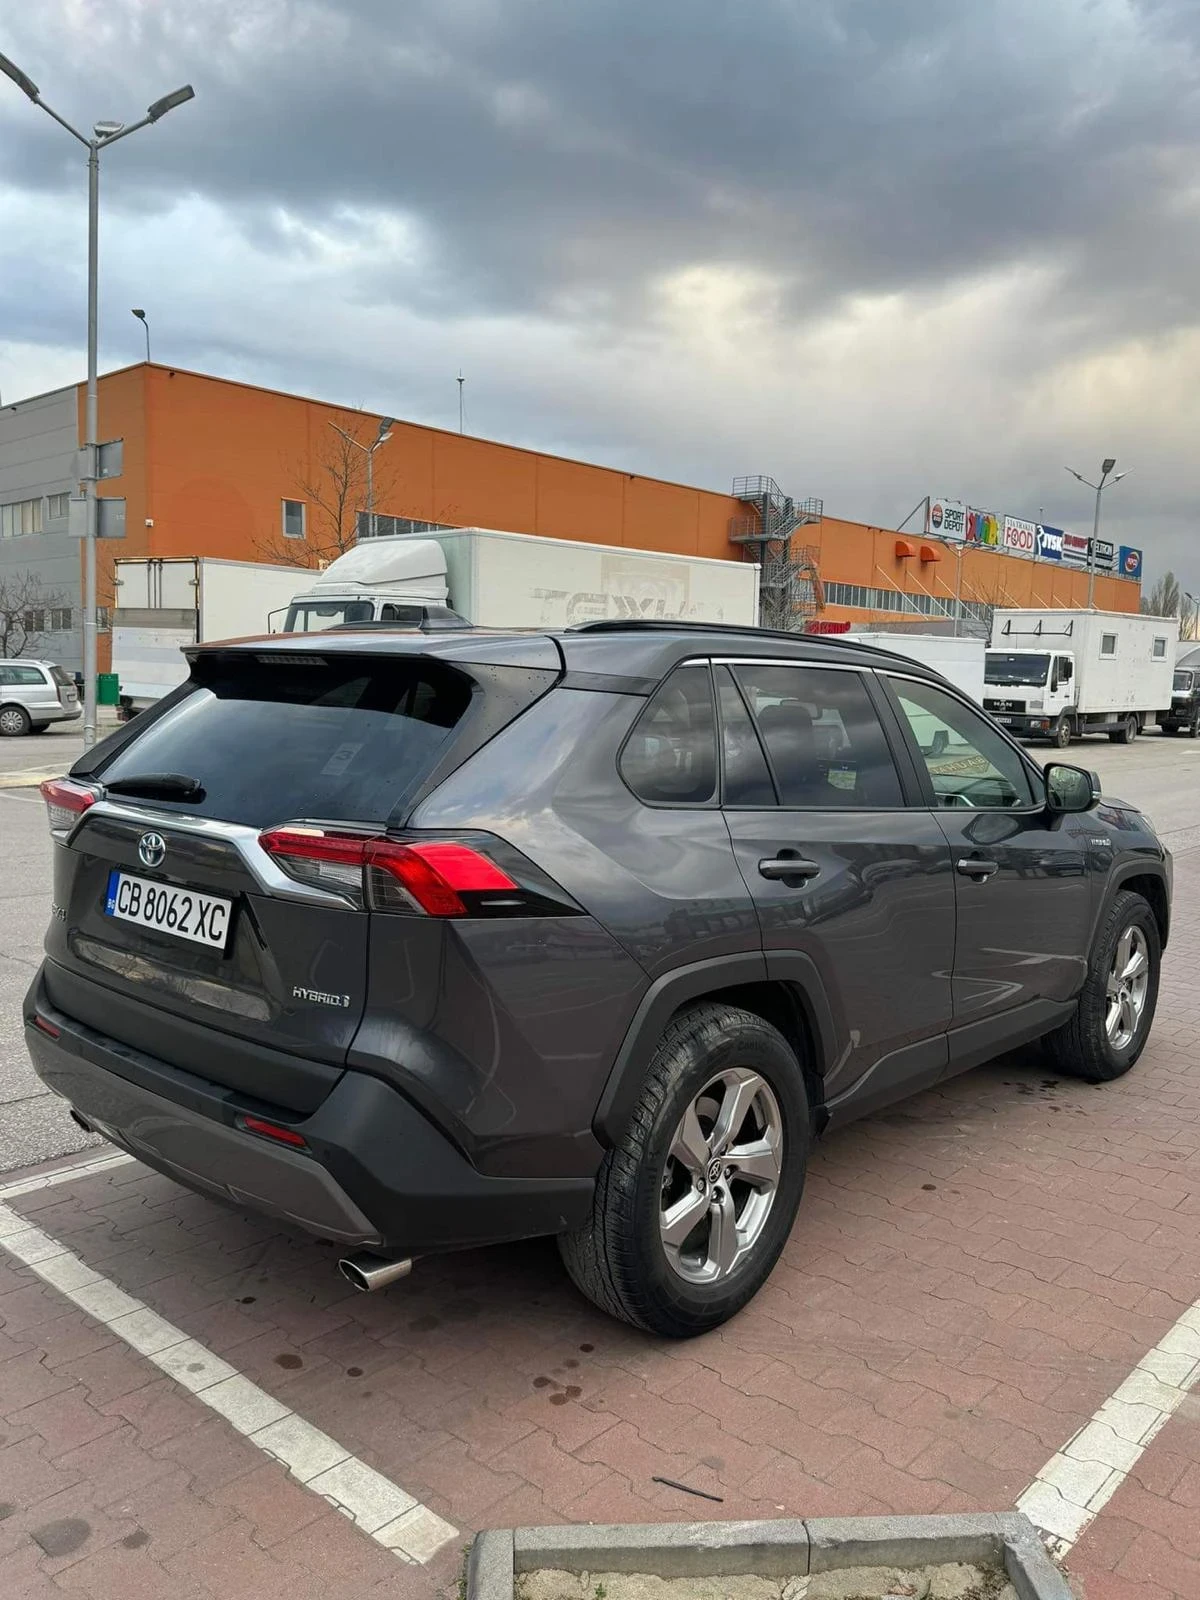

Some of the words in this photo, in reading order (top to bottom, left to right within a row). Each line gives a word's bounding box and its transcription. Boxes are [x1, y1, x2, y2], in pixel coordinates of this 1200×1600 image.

[944, 508, 965, 522] SPORT
[944, 519, 964, 533] DEPOT
[1005, 526, 1034, 549] FOOD
[1042, 533, 1063, 552] JYSK
[107, 898, 116, 910] BG
[118, 880, 142, 917] CB
[144, 887, 193, 933] 8062
[194, 899, 226, 942] XC
[292, 985, 340, 1006] HYBRID
